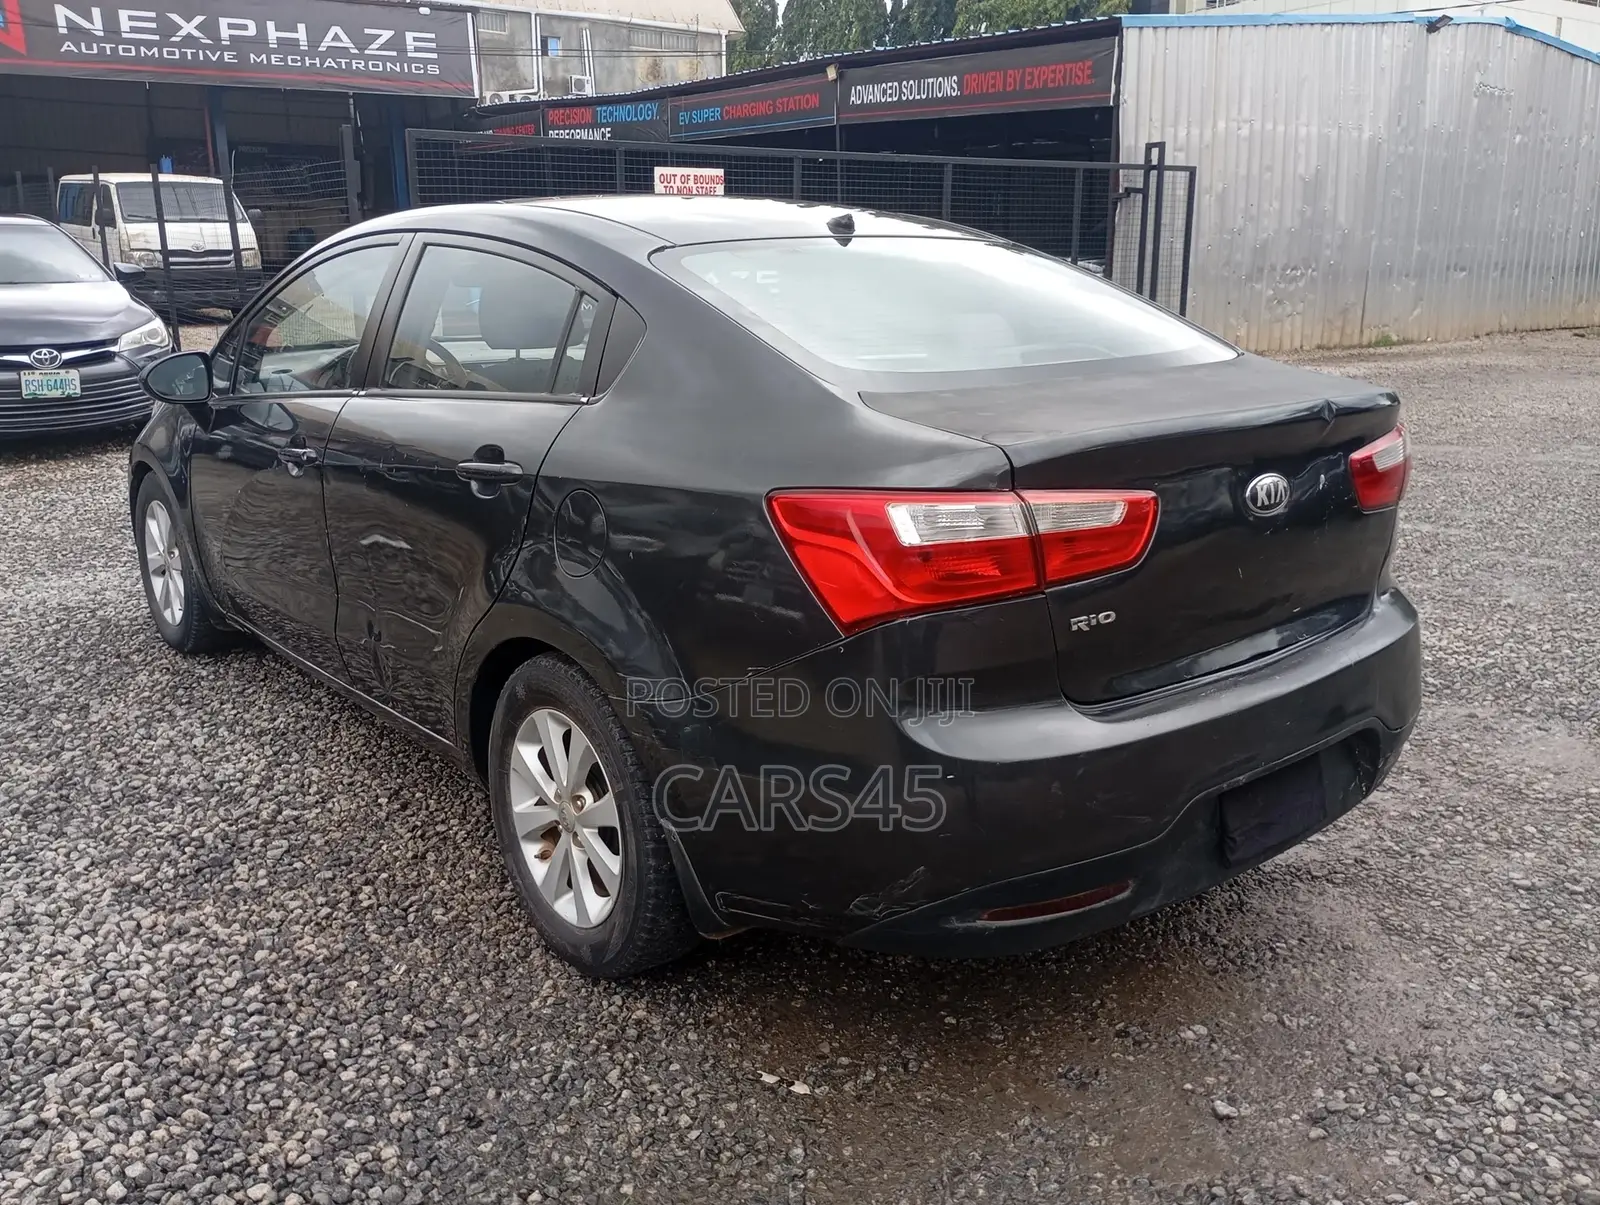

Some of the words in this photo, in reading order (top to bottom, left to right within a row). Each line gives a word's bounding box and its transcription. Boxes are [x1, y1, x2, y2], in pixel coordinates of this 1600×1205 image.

[54, 4, 438, 59] NEXPHAZE
[60, 41, 238, 63] AUTOMOTIVE
[250, 52, 440, 75] MECHATRONICS
[849, 82, 899, 105] ADVANCED
[901, 75, 961, 101] SOLUTIONS.
[963, 70, 1003, 95] DRIVEN
[1006, 69, 1023, 91] BY
[1024, 60, 1095, 89] EXPERTISE.
[596, 102, 660, 124] TECHNOLOGY.
[679, 111, 691, 125] EV
[691, 107, 721, 124] SUPER
[723, 100, 773, 120] CHARGING
[775, 92, 819, 113] STATION
[659, 173, 677, 185] OUT
[680, 174, 691, 185] OF
[693, 174, 724, 186] BOUNDS
[663, 185, 674, 194] TO
[676, 185, 693, 195] NON
[695, 186, 717, 195] STAFF
